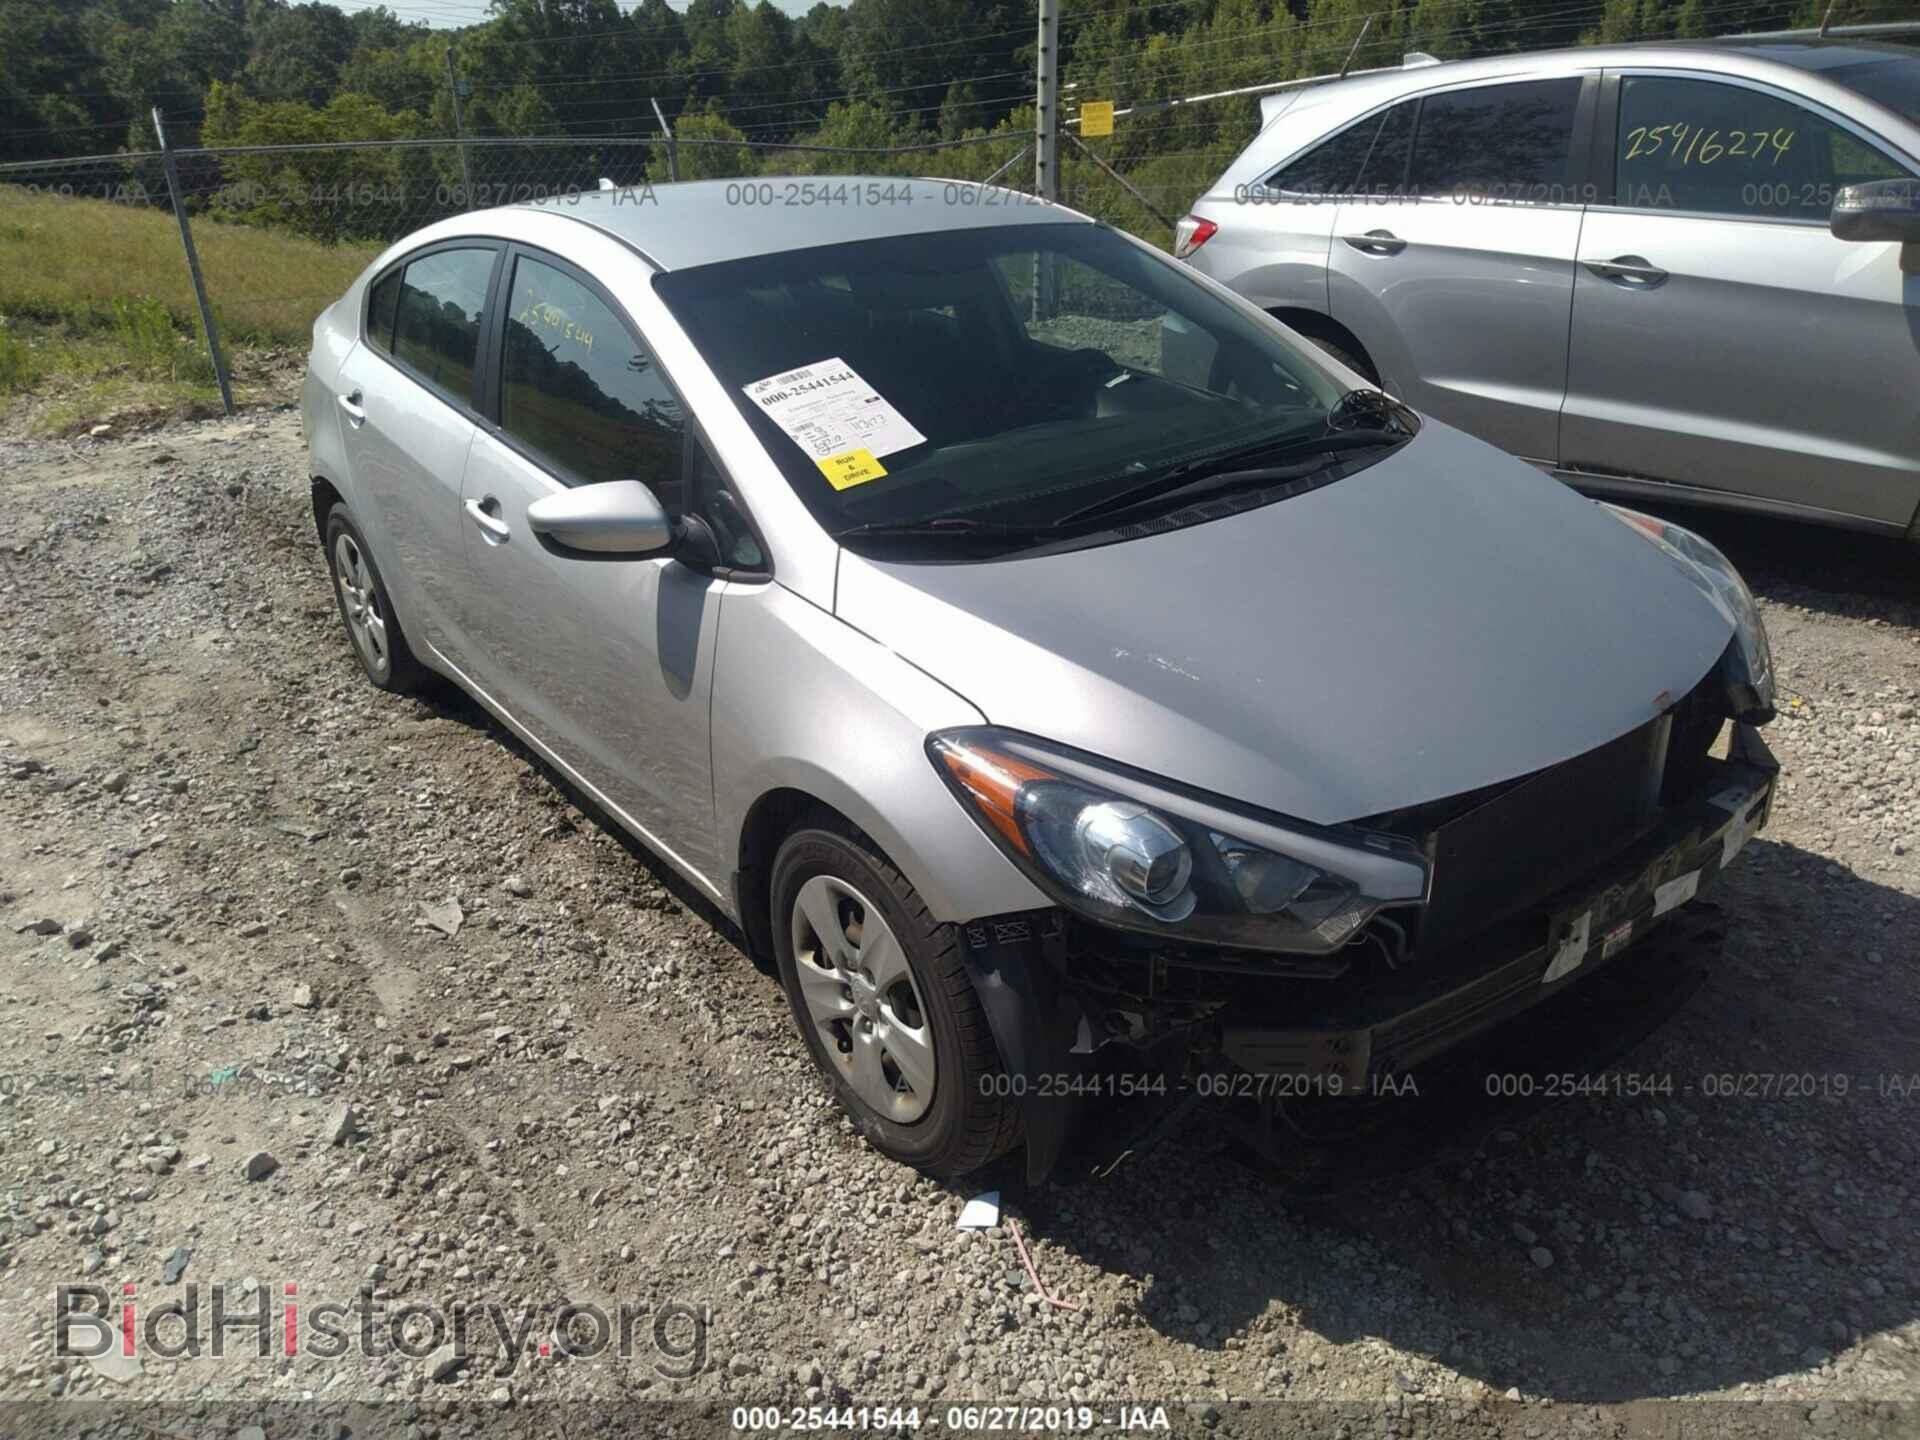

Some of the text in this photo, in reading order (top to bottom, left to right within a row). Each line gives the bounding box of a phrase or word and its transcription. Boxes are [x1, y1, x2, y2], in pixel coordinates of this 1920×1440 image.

[761, 371, 855, 406] 000-25441544
[835, 455, 856, 467] RUN
[843, 468, 871, 481] DRIVE
